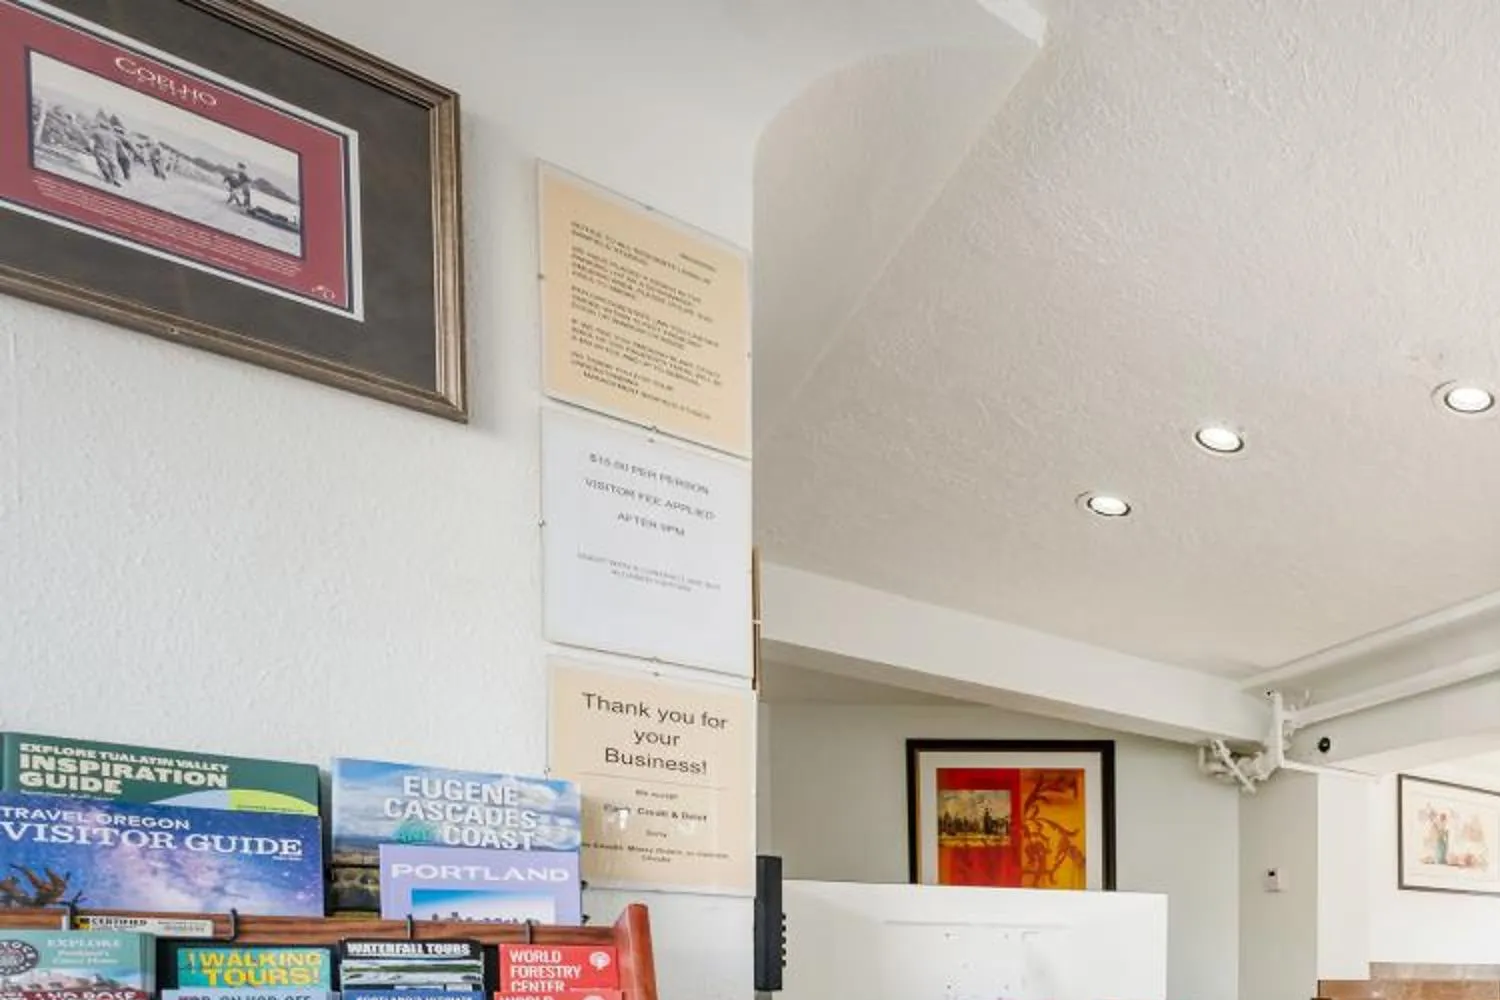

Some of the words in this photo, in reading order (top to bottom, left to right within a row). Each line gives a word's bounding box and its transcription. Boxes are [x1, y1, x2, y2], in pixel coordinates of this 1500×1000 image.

[584, 478, 636, 501] VISITOR
[659, 472, 710, 496] PERSON
[617, 511, 658, 529] AFTER
[582, 692, 651, 719] Thank
[656, 706, 696, 724] you
[700, 711, 728, 730] for
[633, 729, 681, 747] your
[19, 742, 97, 761] EXPLORE
[98, 750, 174, 768] TUALATIN
[175, 757, 230, 773] VALLEY
[604, 747, 708, 775] Business!
[19, 753, 229, 789] INSPIRATION
[19, 771, 122, 795] GUIDE
[402, 775, 520, 807] EUGENE
[2, 807, 90, 824] TRAVEL
[98, 814, 192, 832] OREGON
[383, 797, 538, 830] CASCADES
[0, 819, 178, 850] VISITOR
[184, 831, 304, 856] GUIDE
[444, 822, 537, 851] COAST
[390, 863, 571, 883] PORTLAND
[199, 951, 322, 967] WALKING
[347, 942, 425, 956] WATERFALL
[426, 943, 471, 956] TOURS
[509, 950, 562, 964] WORLD
[202, 967, 322, 989] TOURS!
[510, 964, 582, 979] FORESTRY
[510, 981, 566, 993] CENTER
